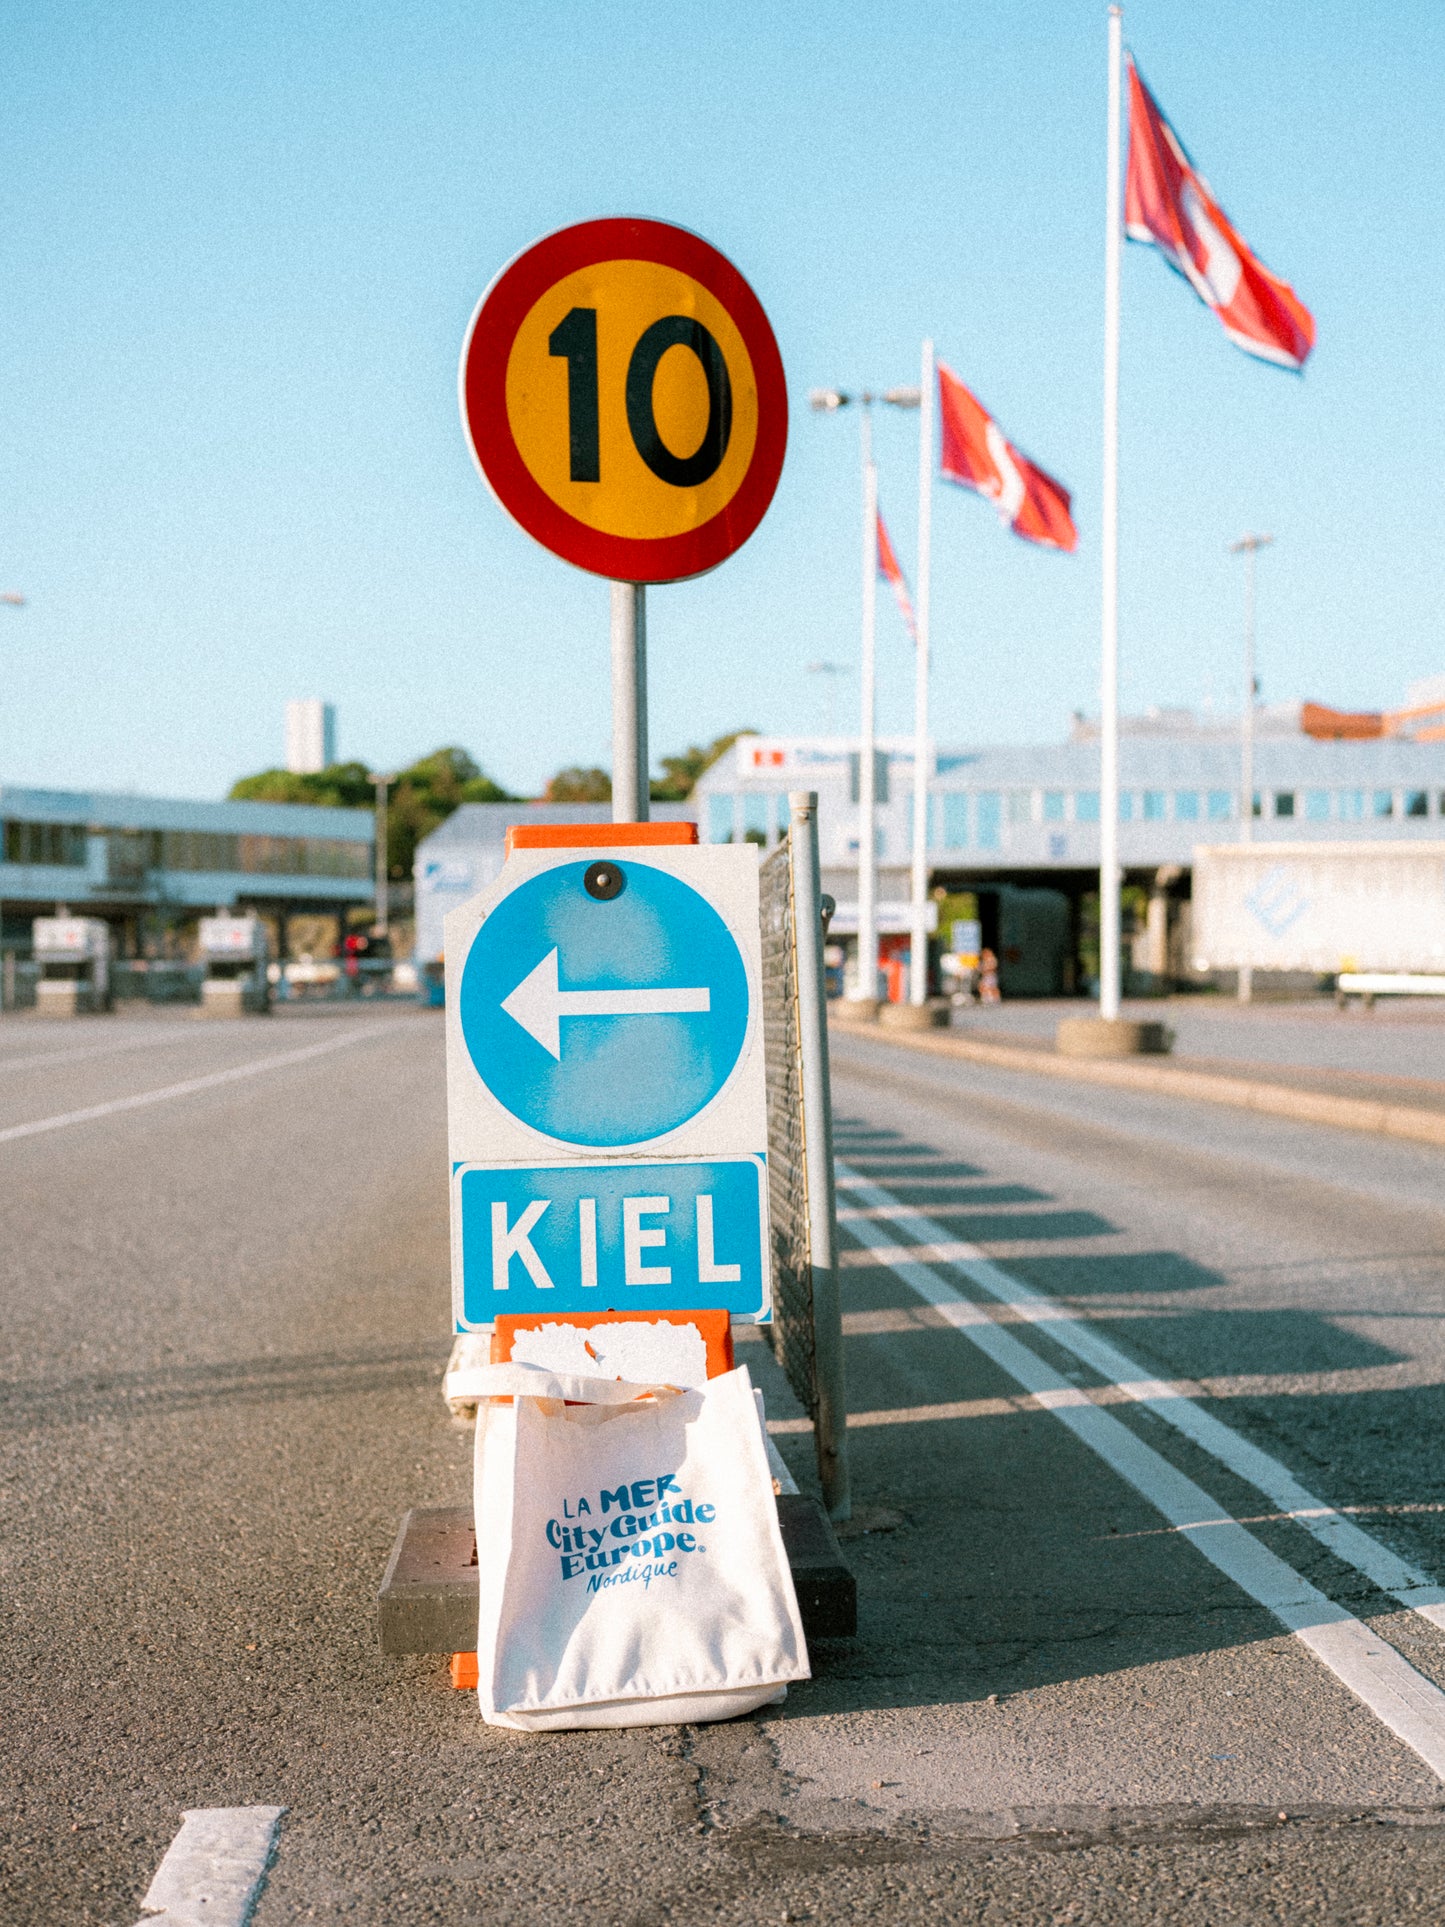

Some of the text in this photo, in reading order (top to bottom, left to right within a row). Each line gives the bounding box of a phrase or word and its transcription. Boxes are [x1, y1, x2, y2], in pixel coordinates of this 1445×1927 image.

[548, 307, 733, 488] 10
[491, 1194, 742, 1290] KIEL
[563, 1473, 682, 1519] LA MER
[586, 1560, 679, 1594] Nordique
